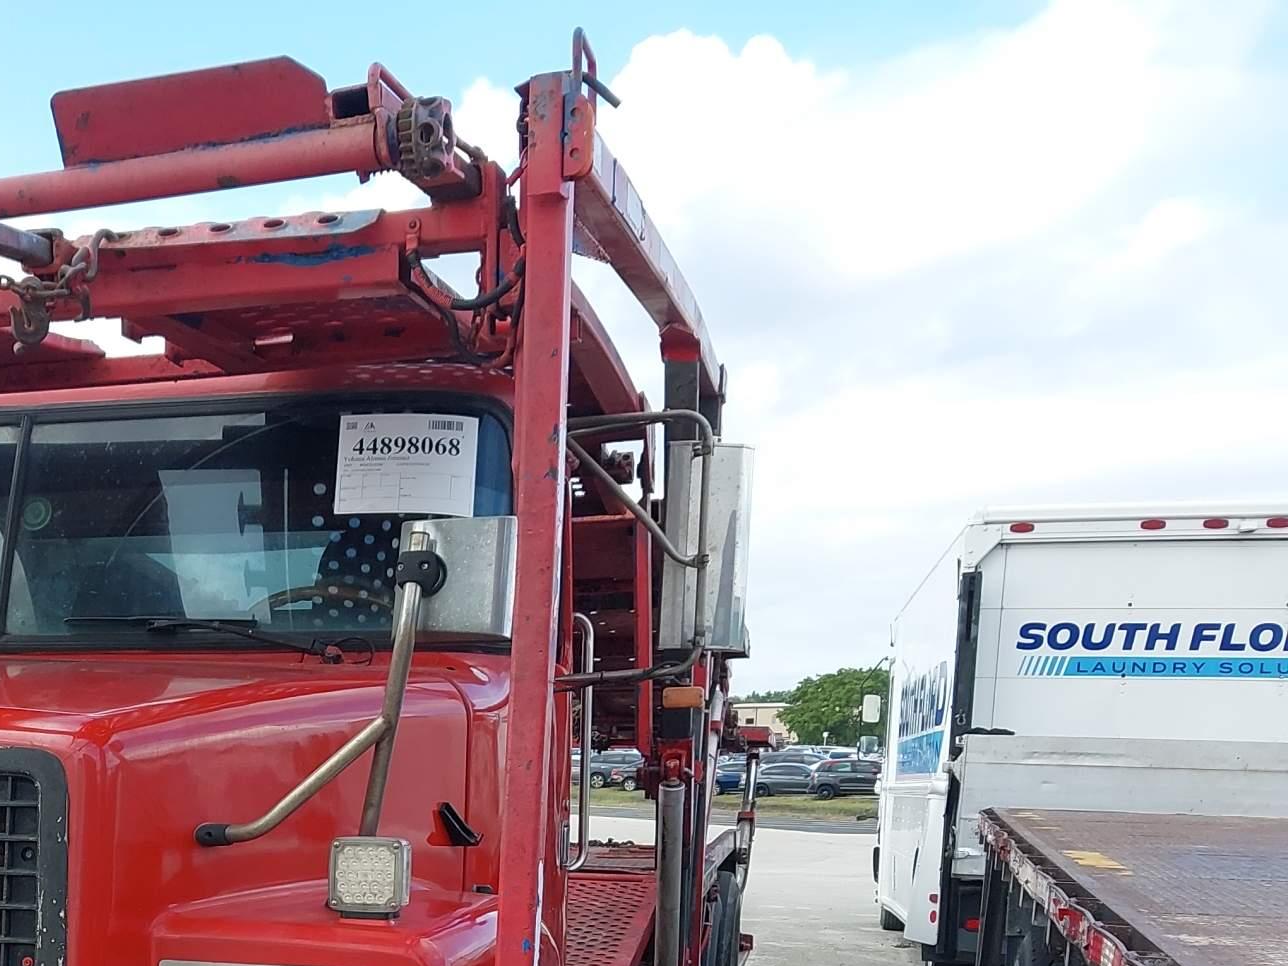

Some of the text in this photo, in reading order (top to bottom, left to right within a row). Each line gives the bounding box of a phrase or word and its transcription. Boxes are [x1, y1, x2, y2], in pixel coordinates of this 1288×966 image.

[352, 436, 460, 456] 44898068
[1015, 622, 1288, 652] SOUTH FLO
[1076, 661, 1206, 674] LAUNDRY
